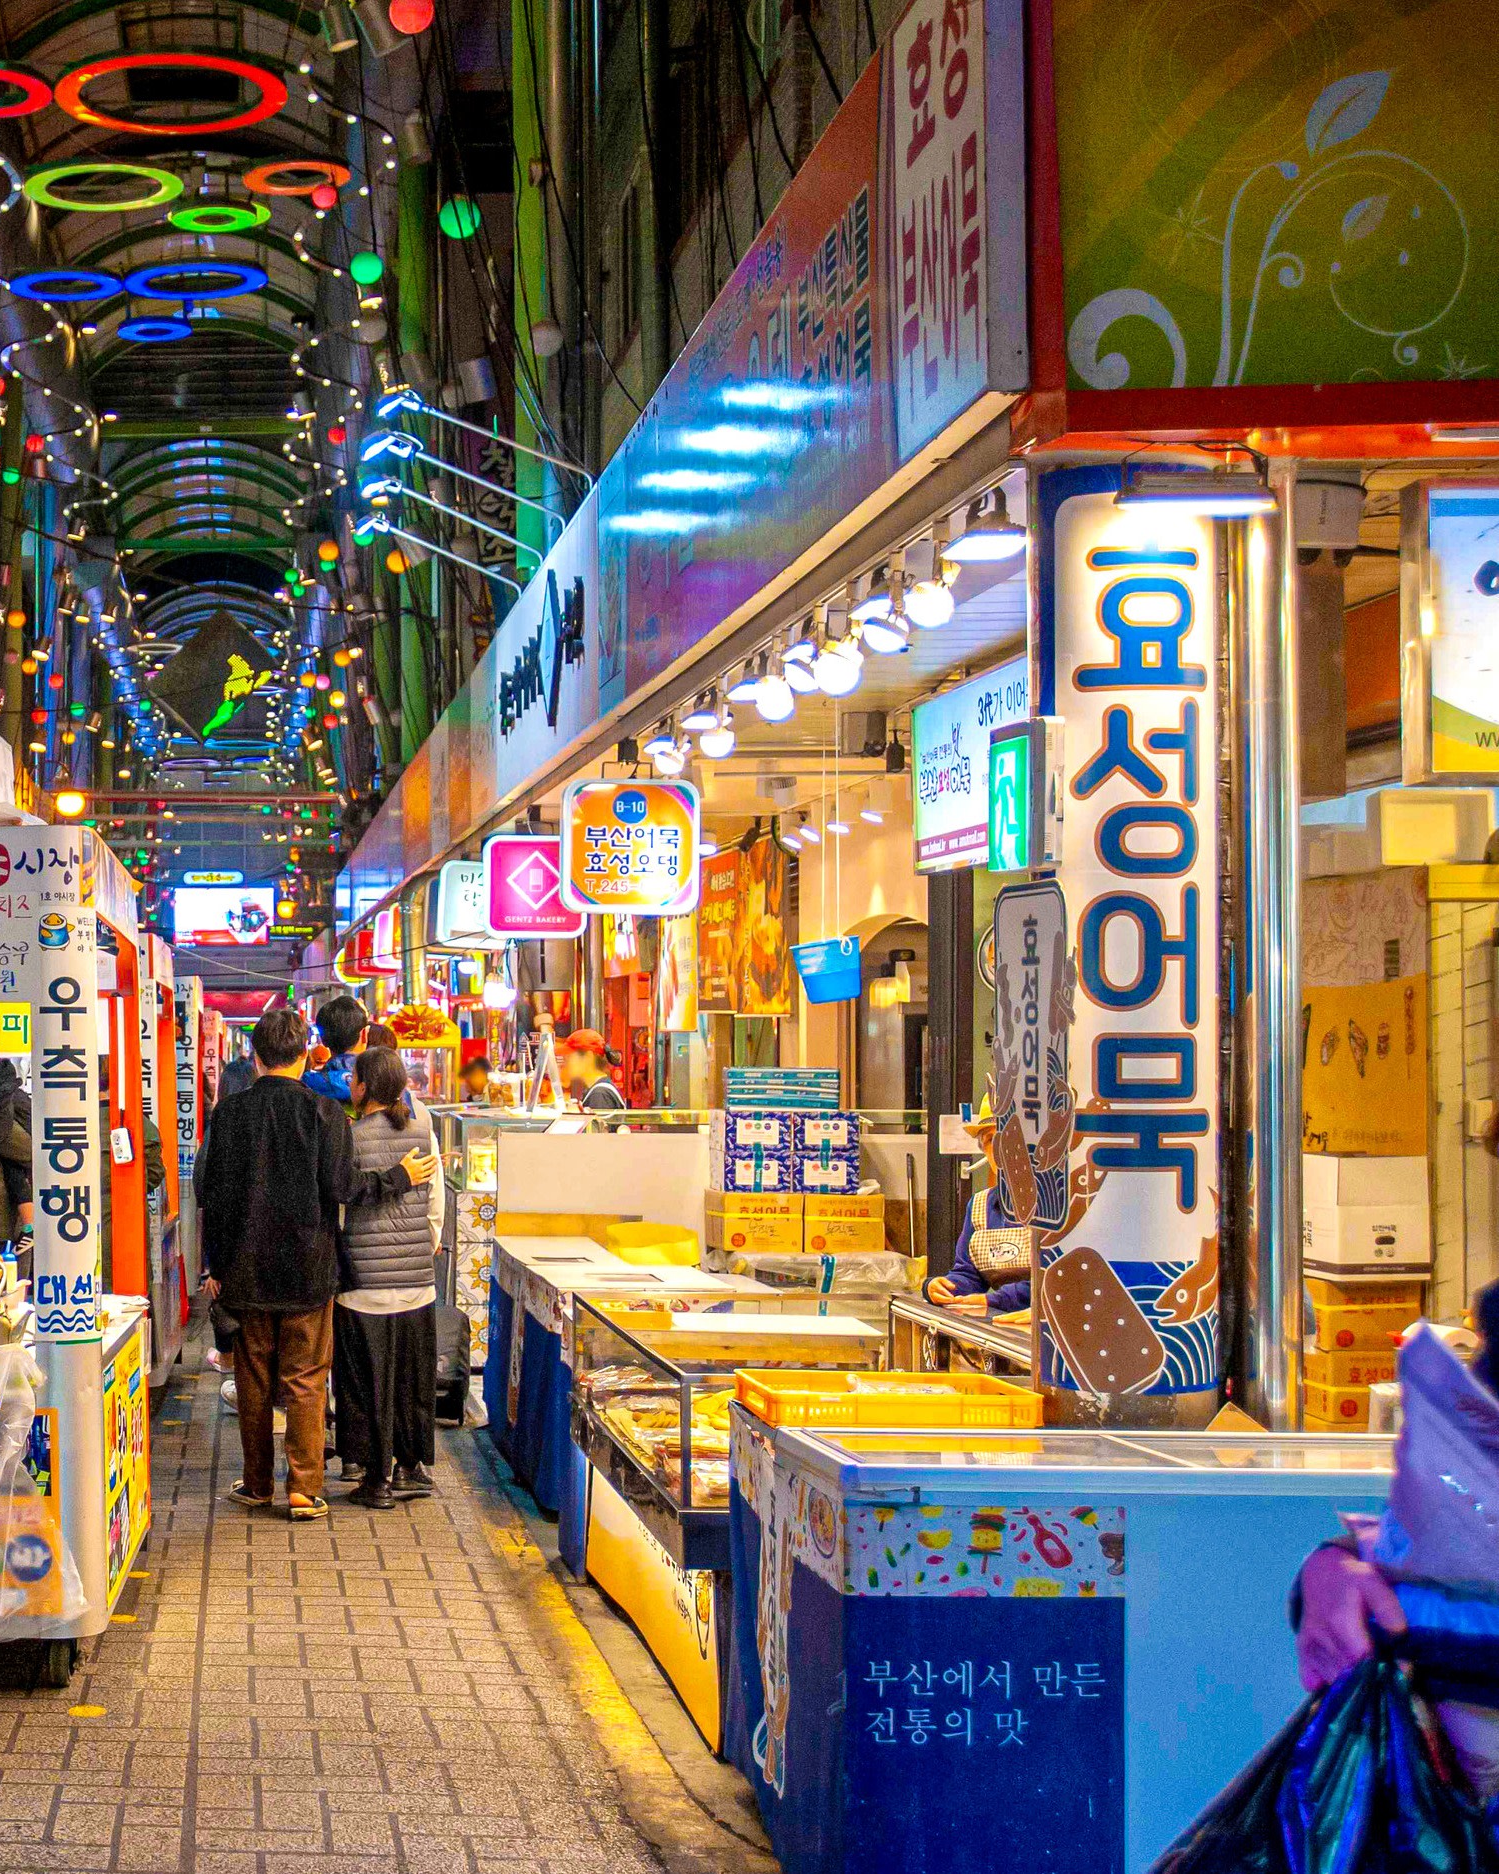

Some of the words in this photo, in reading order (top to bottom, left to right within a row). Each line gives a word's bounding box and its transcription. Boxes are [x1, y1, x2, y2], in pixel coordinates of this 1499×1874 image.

[615, 801, 645, 813] B-10
[584, 826, 680, 850] 부산어묵
[584, 852, 678, 877] 효성오뎅
[1068, 544, 1211, 1215] 효성어묵
[535, 915, 567, 924] BAKERY
[1021, 913, 1042, 1135] 효성어묵
[37, 975, 91, 1243] 우측통행
[36, 1272, 94, 1306] 대선
[863, 1660, 1014, 1700] 부산에서
[1033, 1661, 1107, 1699] 만든
[865, 1708, 976, 1747] 전통의
[998, 1708, 1030, 1746] 맛
